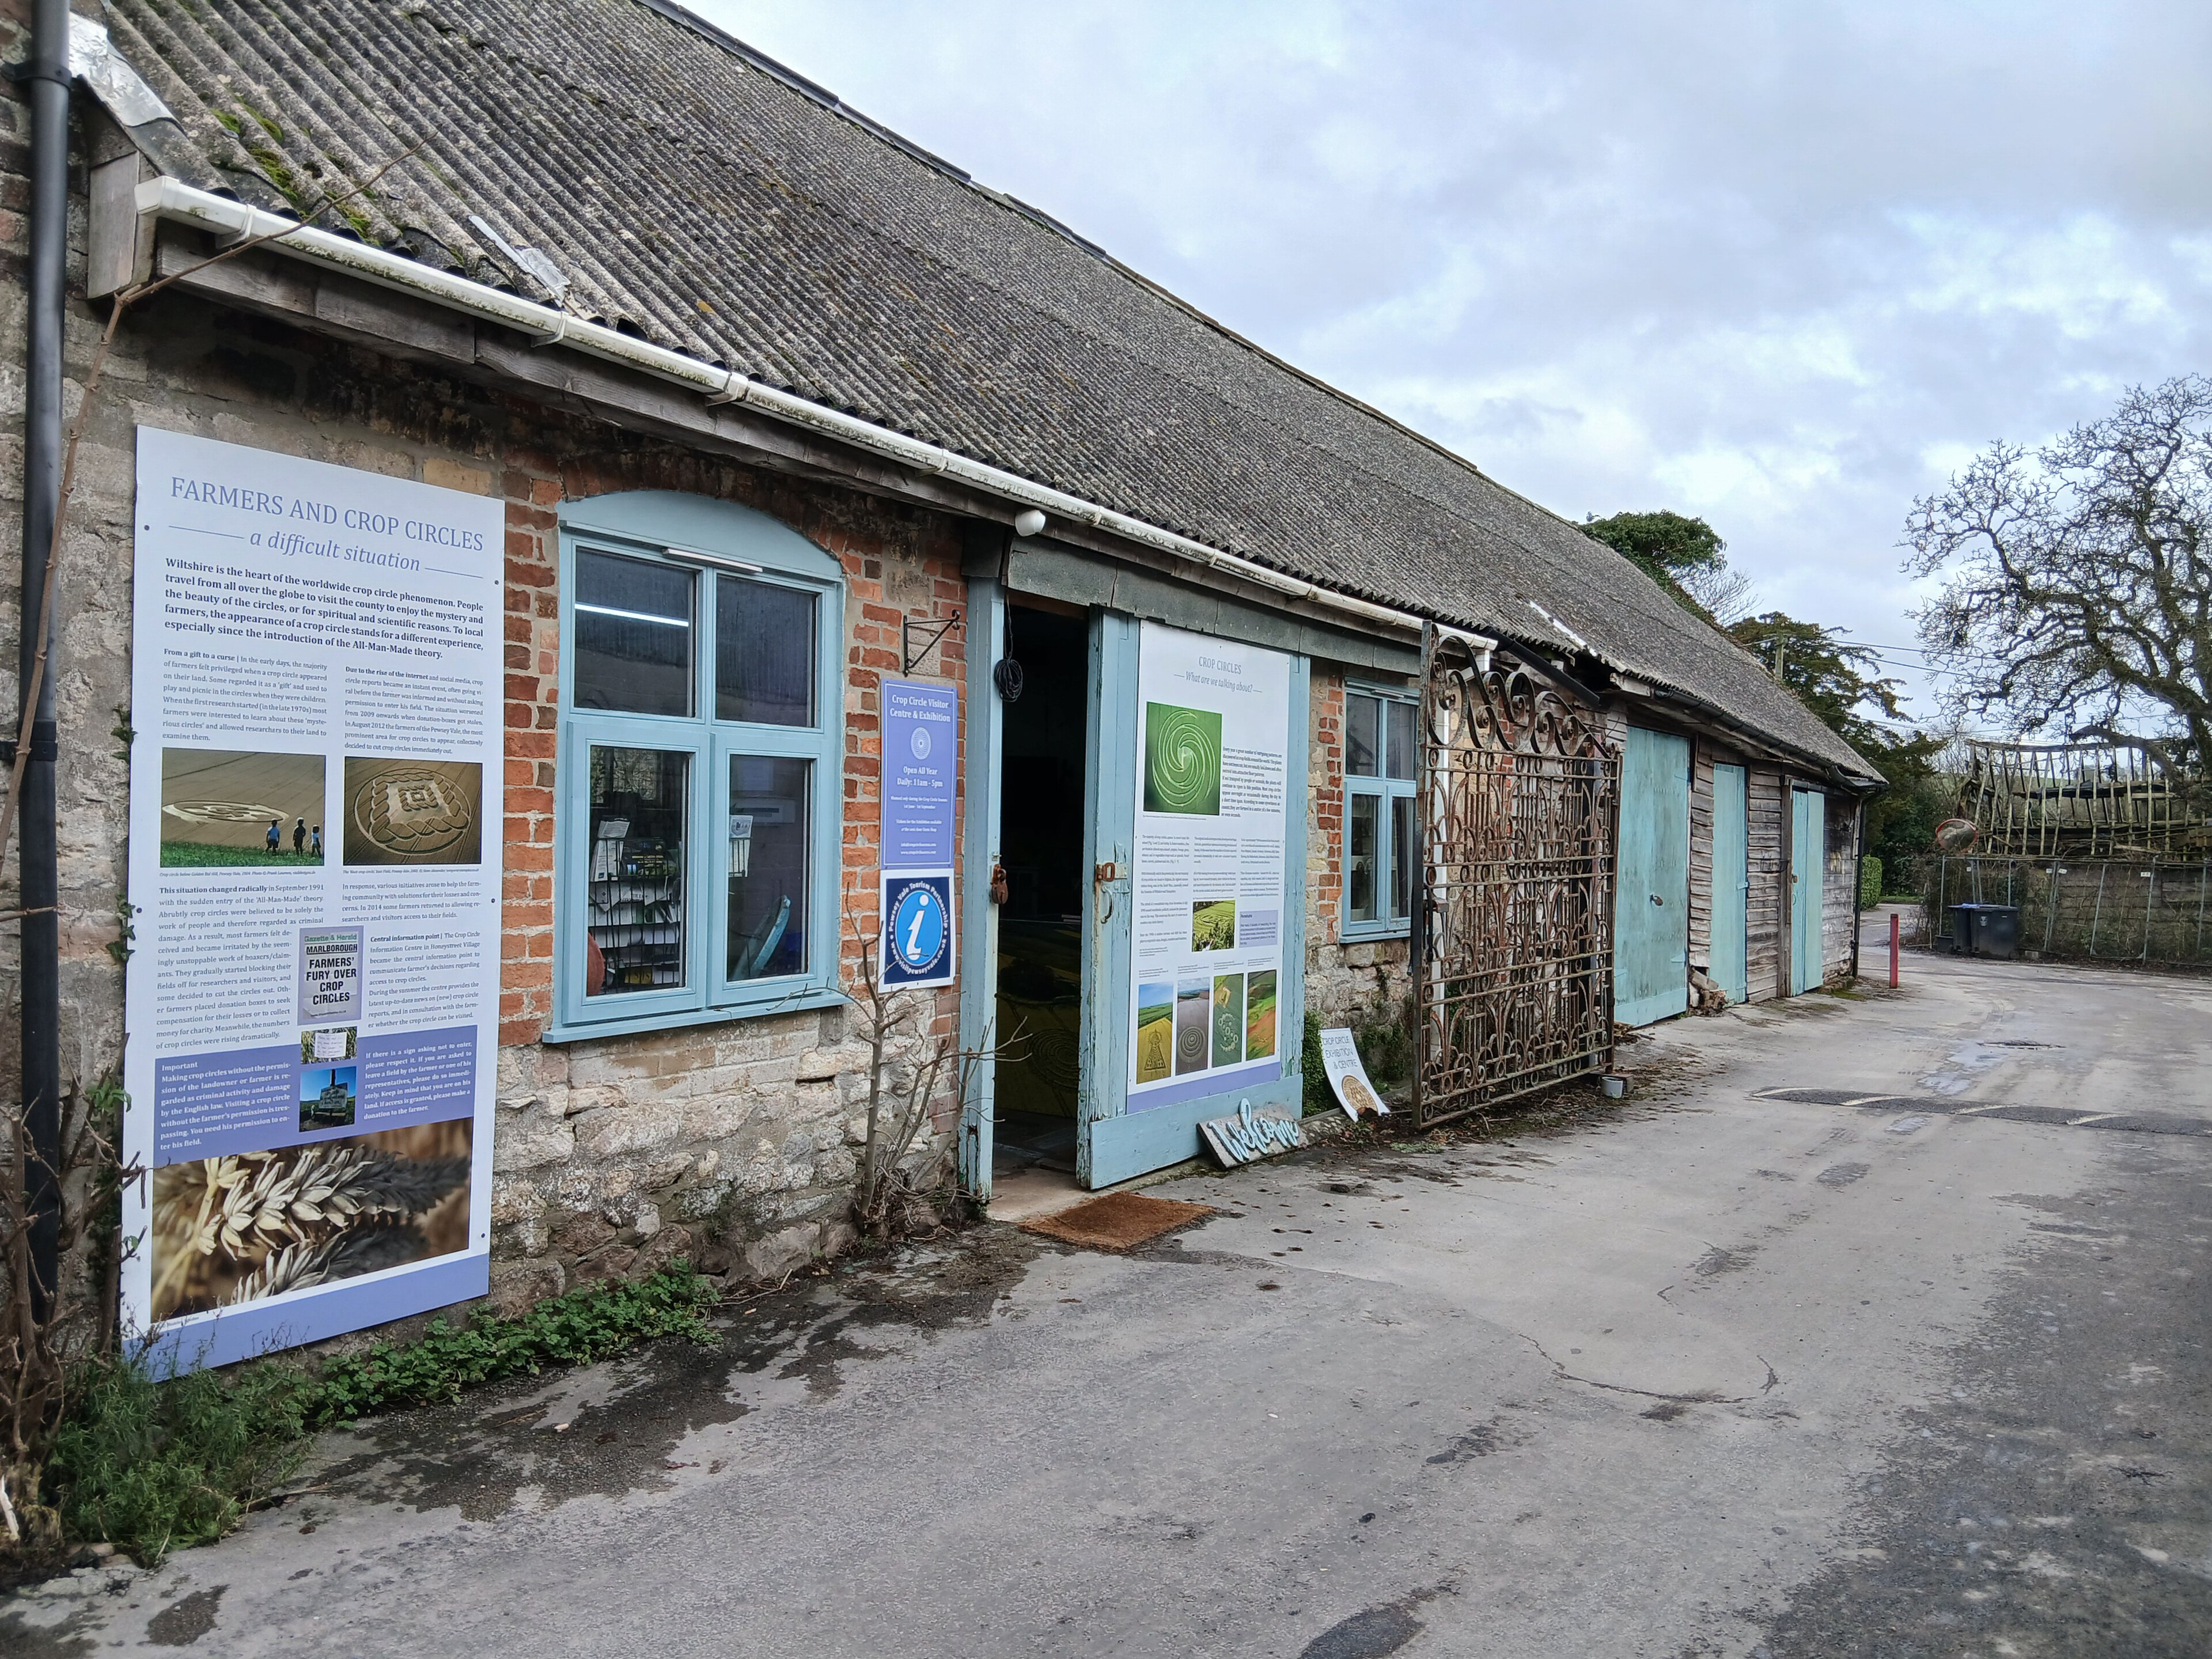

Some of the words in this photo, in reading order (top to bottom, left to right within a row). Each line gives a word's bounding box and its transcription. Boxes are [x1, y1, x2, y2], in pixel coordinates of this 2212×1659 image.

[171, 476, 282, 515] FARMERS
[288, 499, 337, 524] AND
[344, 509, 399, 535] CROP
[405, 520, 483, 551] CIRCLES
[250, 533, 261, 546] a
[267, 531, 340, 558] difficult
[343, 546, 419, 571] situation
[165, 558, 213, 572] Wiltshire
[216, 565, 224, 574] is
[226, 567, 243, 576] the
[245, 569, 271, 581] heart
[273, 574, 283, 582] of
[285, 575, 300, 584] the
[302, 579, 350, 592] worldwide
[353, 586, 372, 597] crop
[374, 588, 397, 599] circle
[400, 592, 455, 607] phenomenon.
[457, 600, 483, 611] People
[165, 574, 195, 585] travel
[198, 577, 221, 589] from
[224, 581, 236, 590] all
[238, 585, 260, 593] over
[262, 586, 277, 596] the
[279, 589, 305, 599] globe
[306, 593, 316, 601] to
[317, 594, 338, 604] visit
[339, 597, 353, 606] the
[355, 601, 385, 612] county
[396, 606, 419, 616] enjoy
[421, 608, 434, 617] the
[435, 612, 467, 623] mystery
[468, 616, 483, 624] and
[165, 589, 181, 599] the
[184, 590, 219, 605] beauty
[222, 596, 233, 605] of
[234, 597, 250, 607] the
[253, 600, 286, 612] circles,
[302, 605, 316, 615] for
[317, 609, 356, 620] spiritual
[358, 615, 375, 623] and
[377, 616, 415, 628] scientific
[418, 623, 451, 632] reasons.
[453, 626, 463, 634] To
[464, 627, 483, 637] local
[165, 604, 208, 618] farmers,
[210, 609, 226, 619] the
[227, 613, 284, 626] appearance
[286, 619, 296, 627] of
[303, 622, 324, 632] crop
[325, 623, 350, 634] circle
[351, 627, 380, 637] stands
[381, 630, 394, 639] for
[401, 632, 437, 644] different
[438, 639, 483, 650] experience,
[164, 621, 215, 635] especially
[217, 626, 243, 635] since
[245, 628, 262, 638] the
[264, 630, 323, 645] introduction
[325, 638, 335, 646] of
[336, 638, 350, 647] the
[352, 641, 412, 654] All-Man-Made
[414, 647, 442, 659] theory.
[275, 659, 291, 667] days,
[302, 662, 327, 671] majority
[1198, 656, 1215, 669] CROP
[1217, 660, 1241, 675] CIRCLES
[1185, 671, 1200, 683] What
[1200, 676, 1210, 684] are
[1210, 678, 1218, 686] we
[1218, 678, 1235, 692] talking
[1236, 681, 1253, 692] about?
[892, 694, 908, 706] Crop
[908, 696, 927, 706] Circle
[928, 698, 949, 708] Visitor
[889, 707, 911, 718] Centre
[912, 710, 918, 718] &
[919, 711, 950, 722] Exhibition
[903, 766, 917, 775] Open
[897, 778, 912, 787] Daily:
[931, 779, 942, 788] 5pm
[209, 885, 237, 893] changed
[306, 944, 358, 954] MARLBOROUGH
[309, 957, 355, 969] FARMERS'
[306, 970, 330, 981] FURY
[334, 968, 357, 979] OVER
[320, 981, 344, 992] CROP
[313, 992, 350, 1005] CIRCLES
[1325, 1048, 1353, 1058] EXHIBITION
[161, 1074, 188, 1082] Making
[204, 1069, 227, 1077] circles
[266, 1062, 291, 1071] permis-
[162, 1062, 198, 1071] Important
[1207, 1097, 1300, 1162] Welcome
